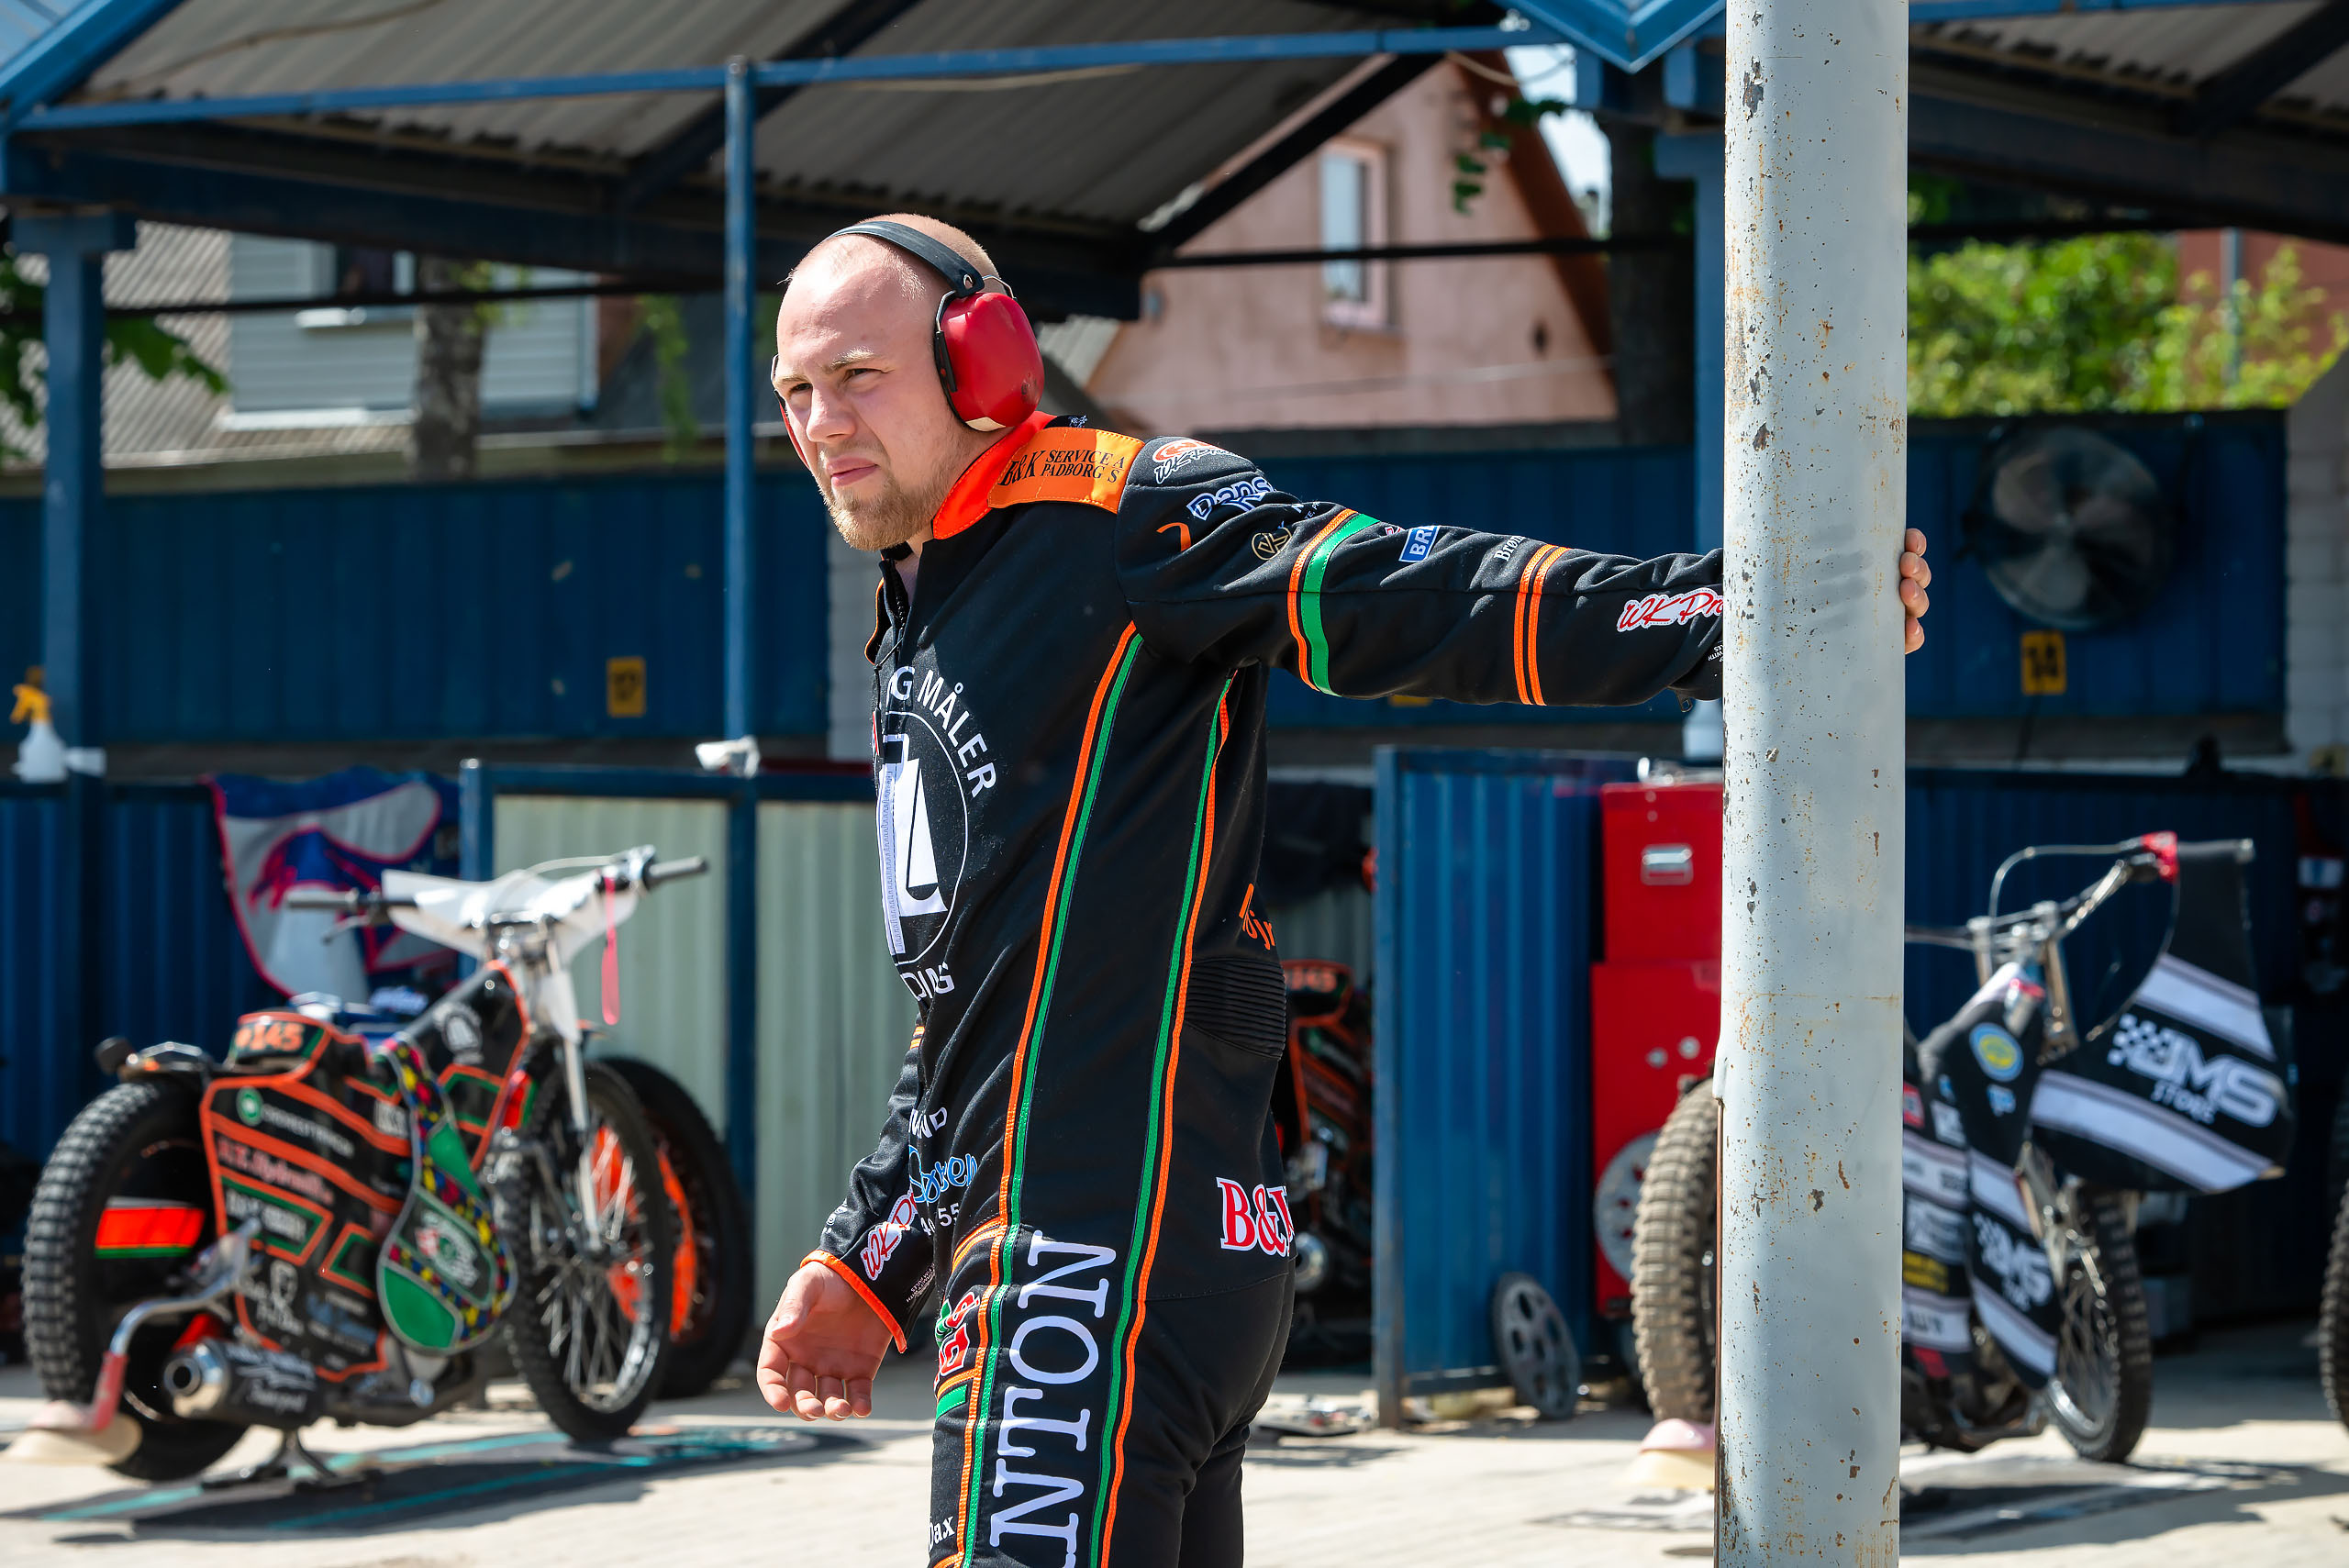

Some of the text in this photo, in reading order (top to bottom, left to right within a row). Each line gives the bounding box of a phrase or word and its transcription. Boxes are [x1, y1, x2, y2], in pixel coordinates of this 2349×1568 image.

[997, 450, 1046, 486] B&K
[1046, 450, 1114, 466] SERVICE
[1041, 462, 1106, 479] PADBORG
[1618, 595, 1681, 631] WK
[917, 669, 996, 798] MÅLER
[990, 1230, 1117, 1568] NTON
